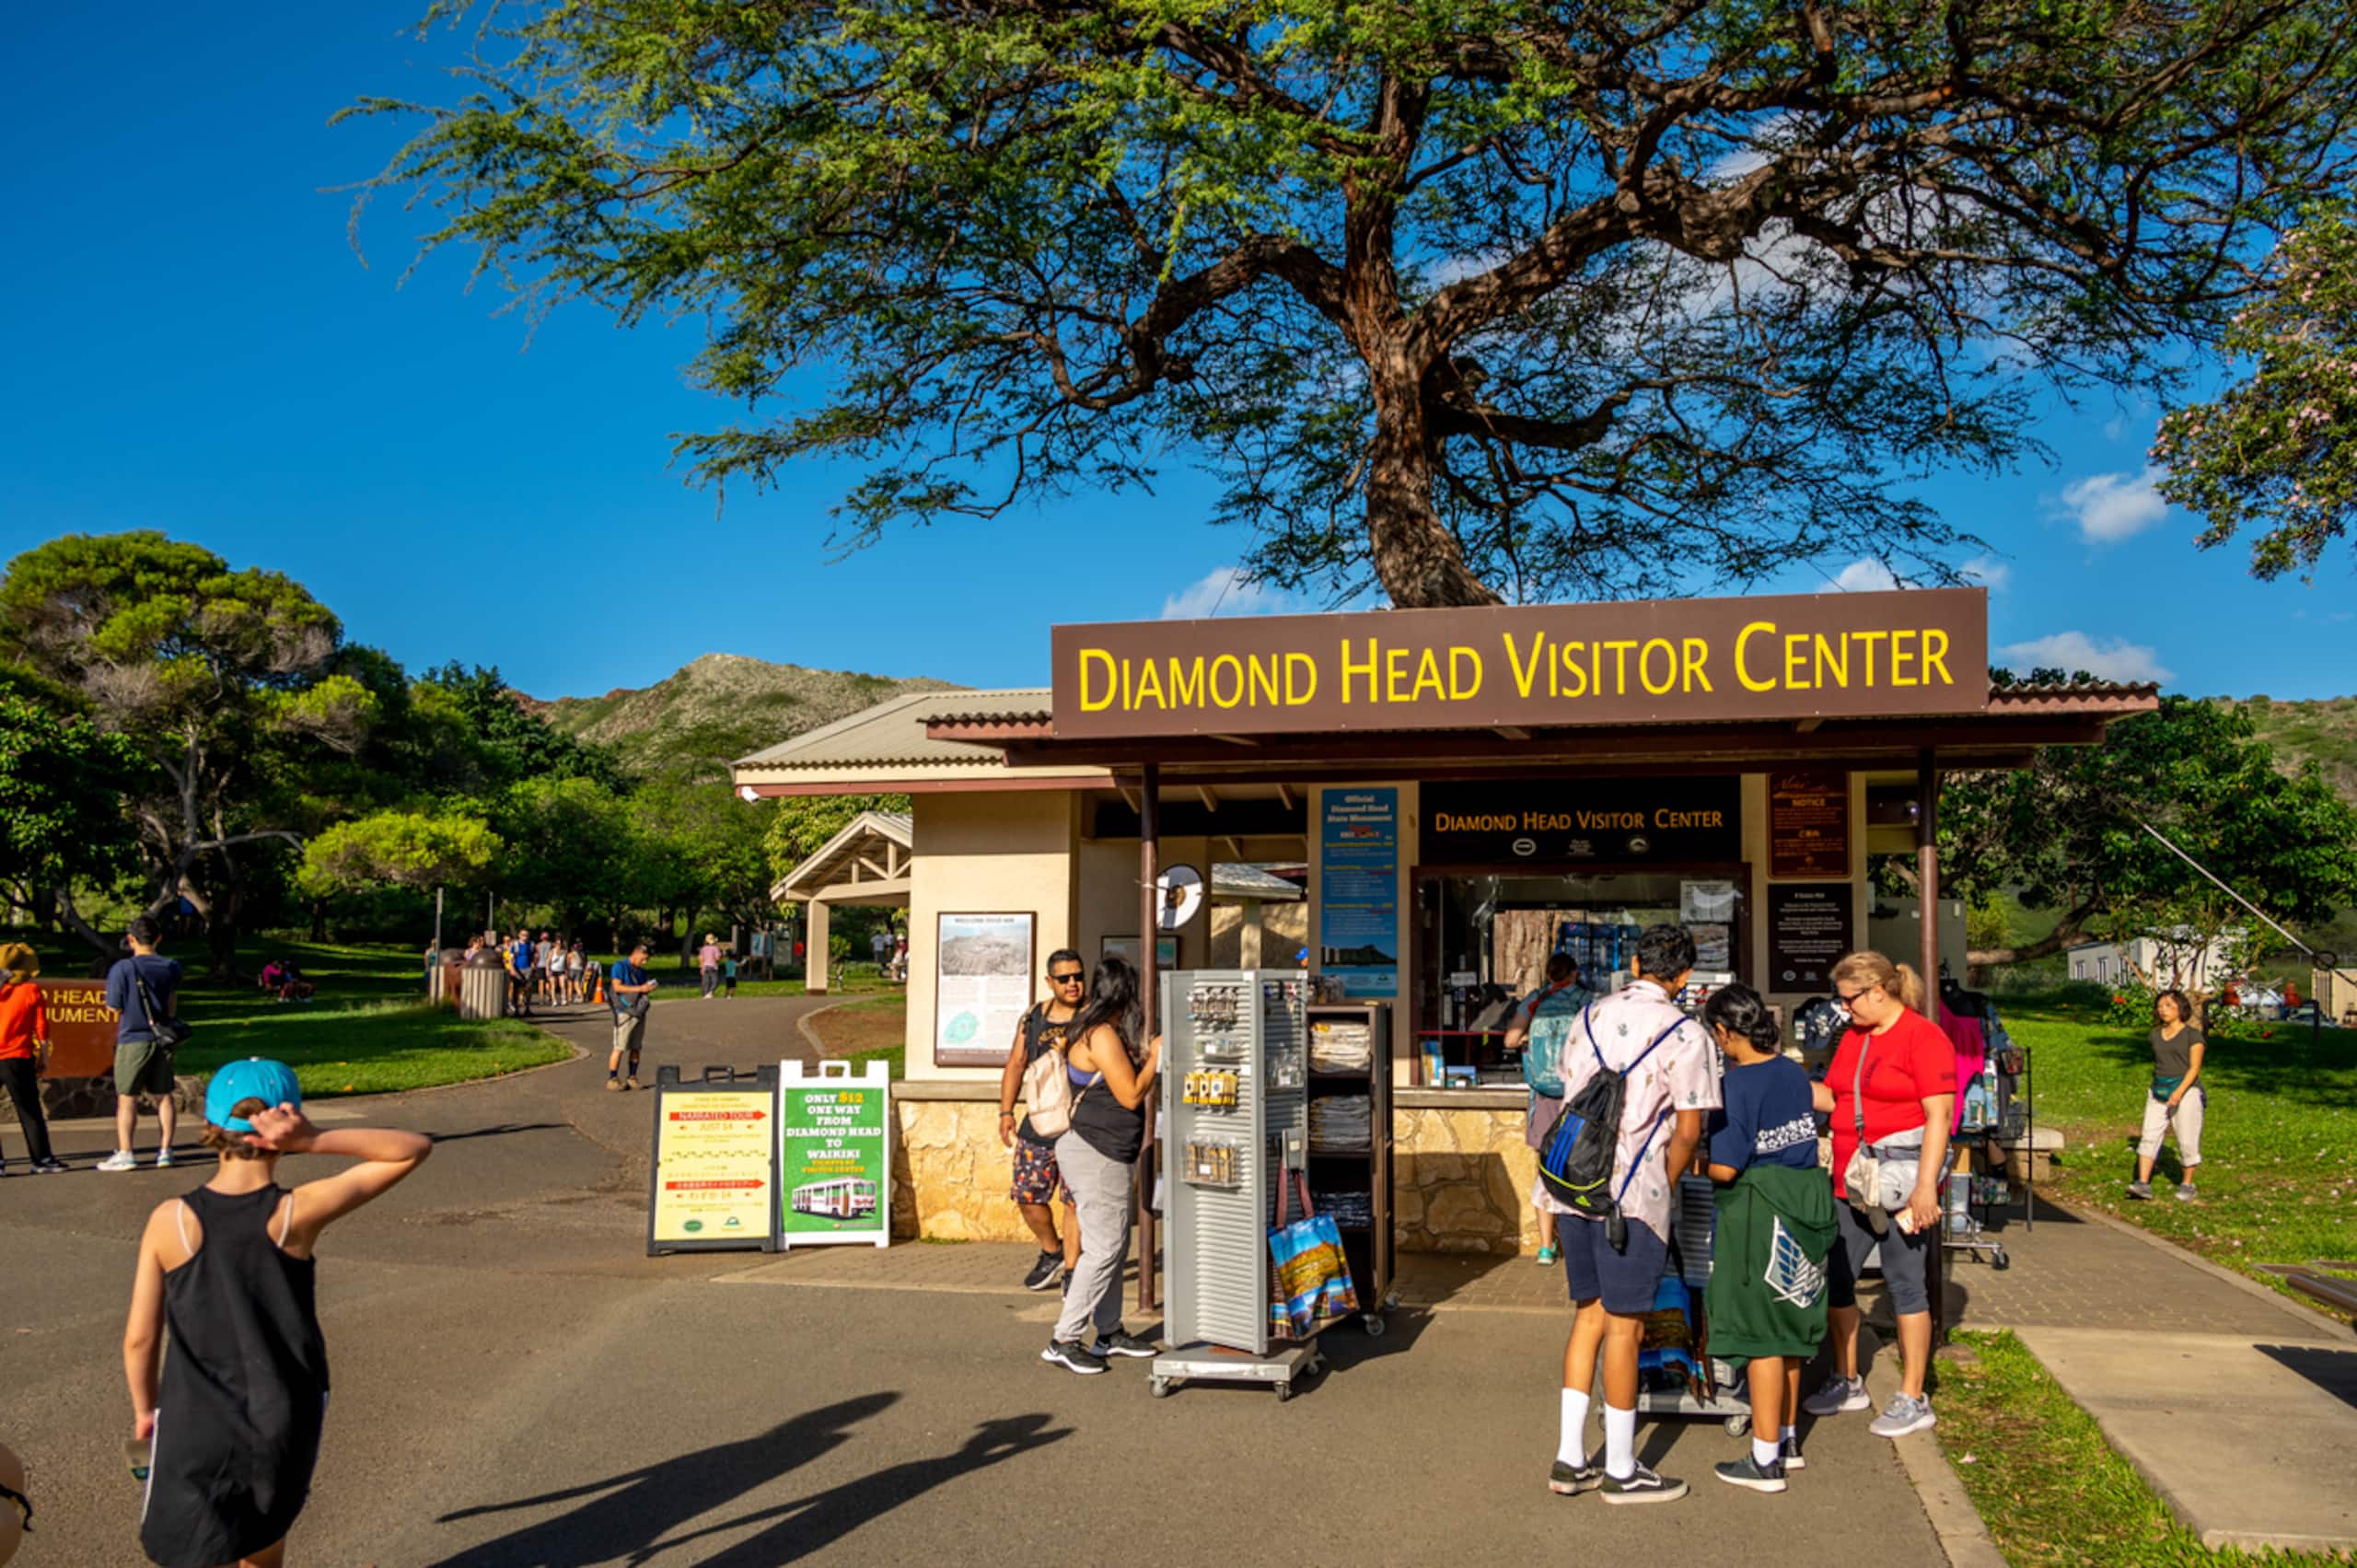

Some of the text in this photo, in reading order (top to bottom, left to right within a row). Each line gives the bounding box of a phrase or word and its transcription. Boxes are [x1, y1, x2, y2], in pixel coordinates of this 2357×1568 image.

[1079, 621, 1955, 713] DIAMOND HEAD VISITOR CENTER
[1435, 808, 1723, 832] DIAMOND HEAD VISITOR CENTER
[45, 1007, 121, 1022] UMENT
[805, 1091, 865, 1104] ONLY $12
[807, 1105, 862, 1115] ONE WAY
[817, 1116, 853, 1125] FROM
[786, 1127, 882, 1137] DIAMOND HEAD
[826, 1138, 842, 1148] TO
[807, 1149, 861, 1159] WAIKIKI
